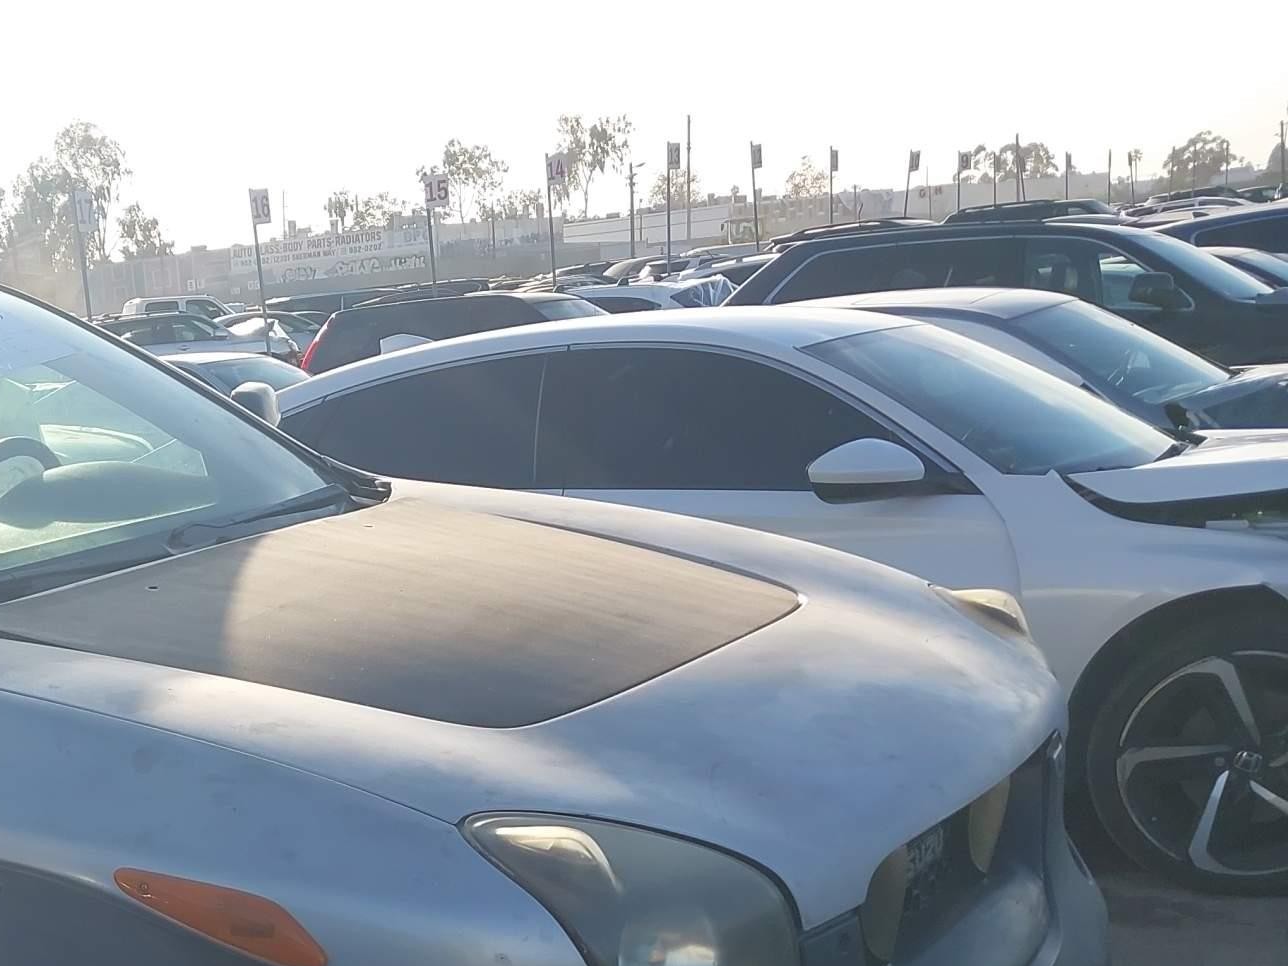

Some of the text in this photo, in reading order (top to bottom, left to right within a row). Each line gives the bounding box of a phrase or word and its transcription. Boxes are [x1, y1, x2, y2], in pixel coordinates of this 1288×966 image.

[547, 159, 565, 180] 14
[961, 154, 969, 168] 9
[425, 180, 448, 202] 15
[252, 195, 271, 218] 16
[233, 247, 253, 258] AUTO
[307, 231, 382, 249] PARTS-RADIATORS
